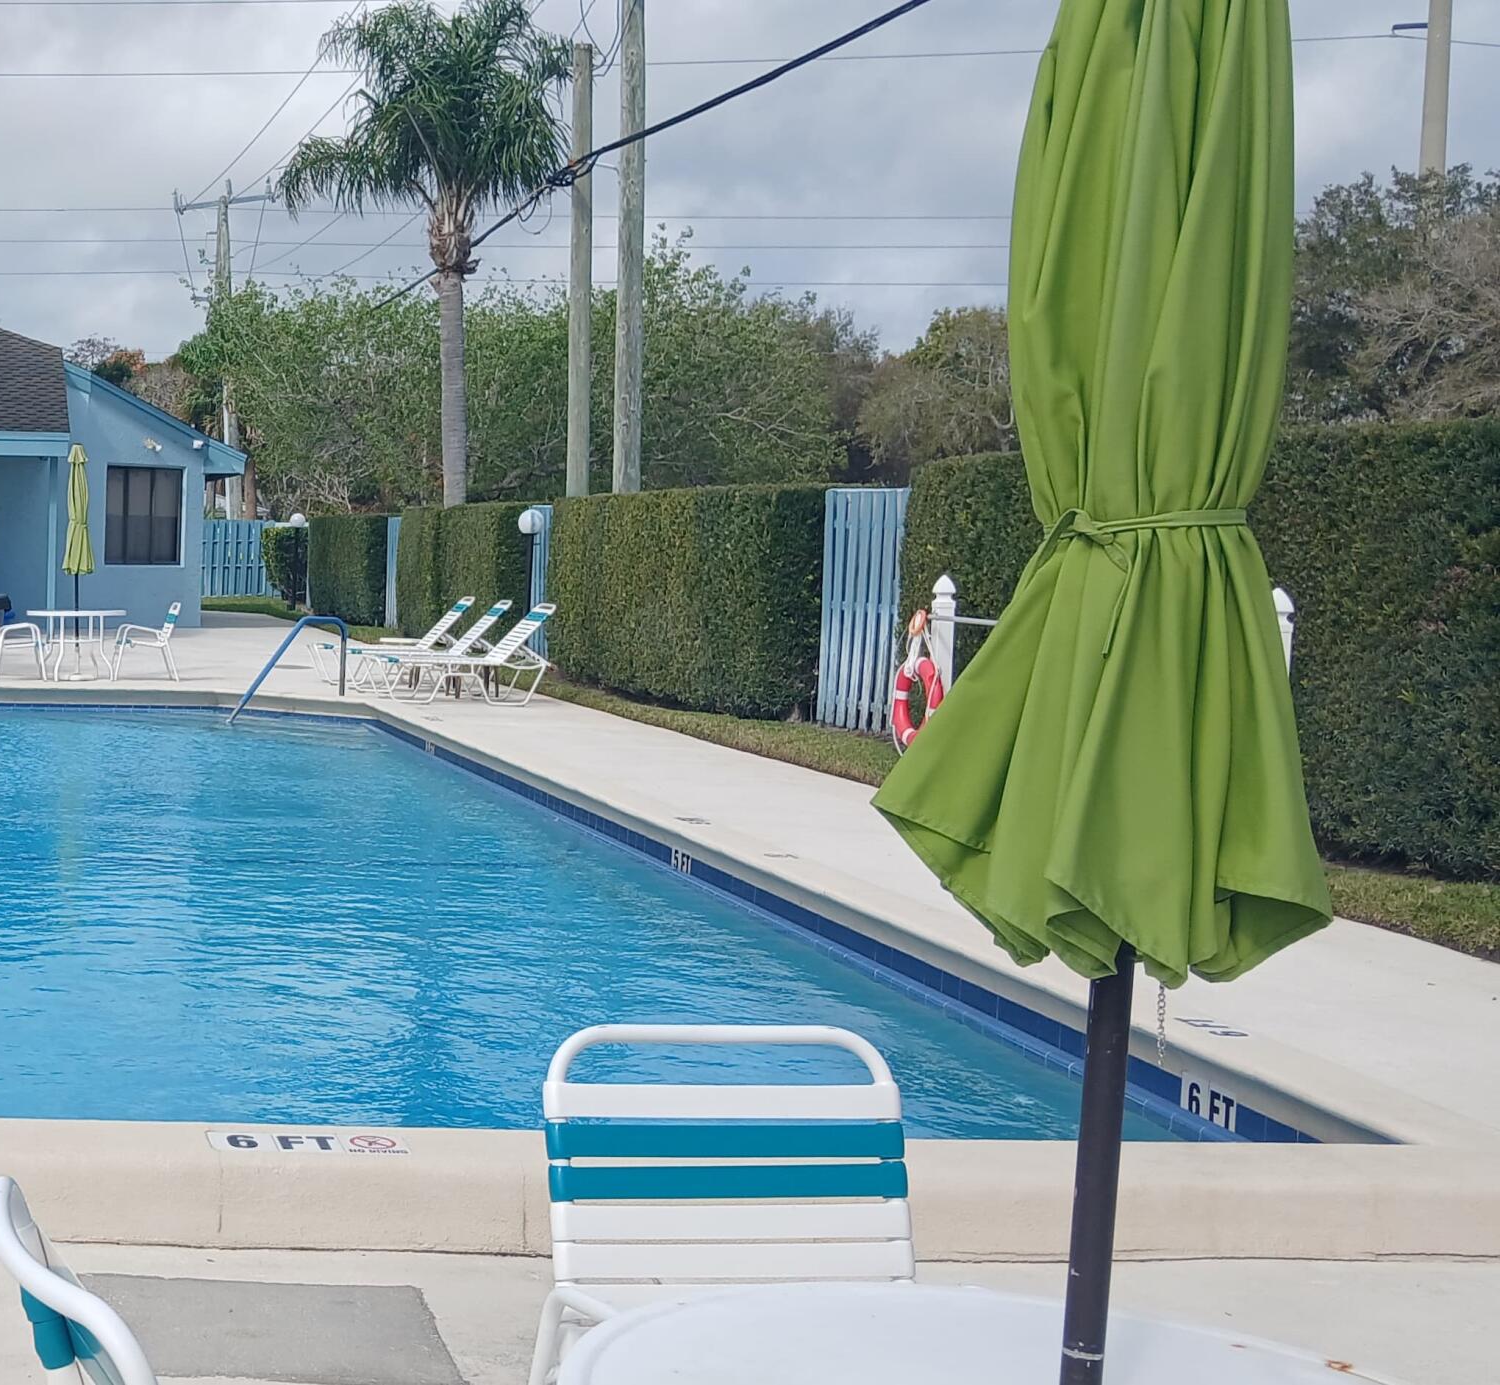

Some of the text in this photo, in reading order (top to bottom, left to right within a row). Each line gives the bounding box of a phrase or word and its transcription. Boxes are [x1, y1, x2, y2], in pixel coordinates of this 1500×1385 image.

[680, 852, 691, 874] FT
[1187, 1082, 1234, 1130] 6 FT
[226, 1134, 335, 1151] 6 FT
